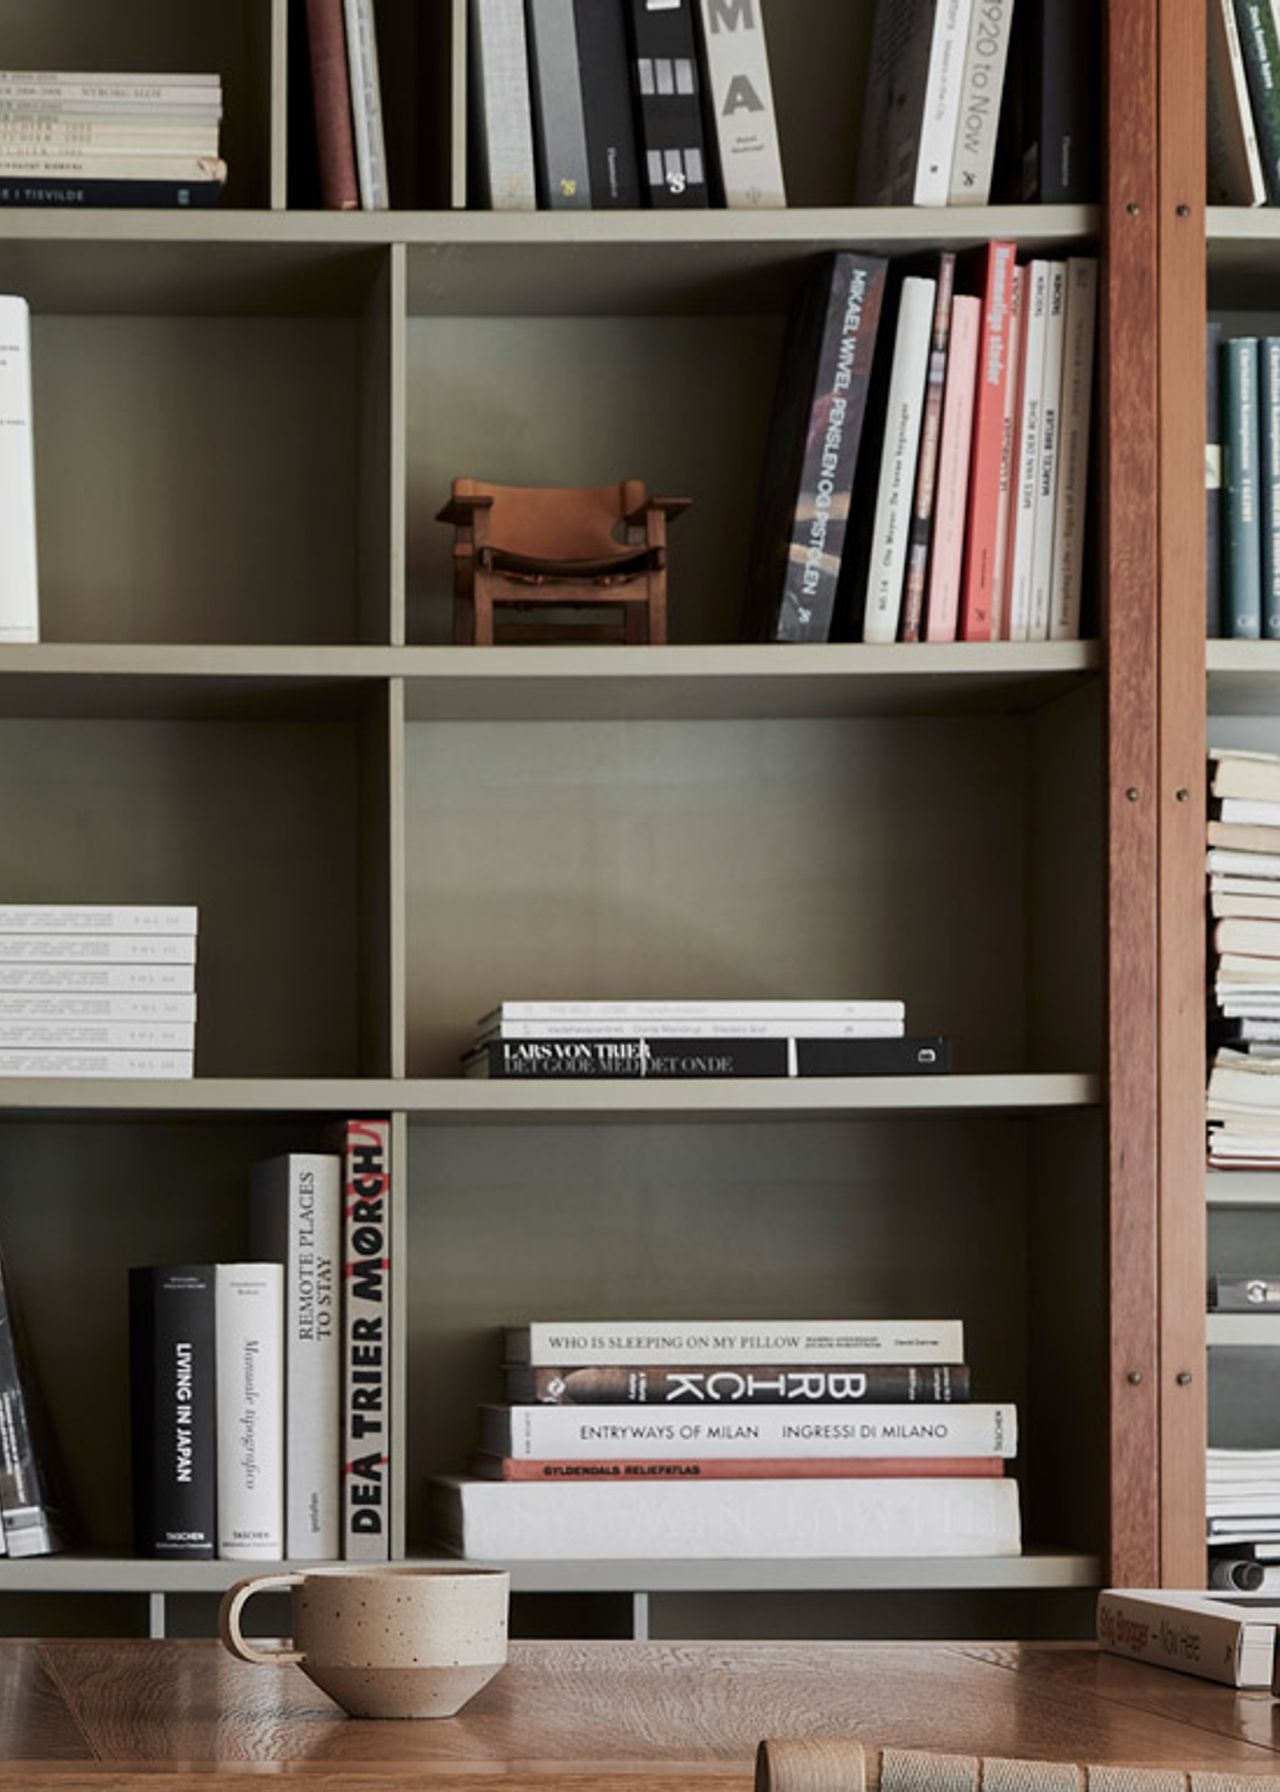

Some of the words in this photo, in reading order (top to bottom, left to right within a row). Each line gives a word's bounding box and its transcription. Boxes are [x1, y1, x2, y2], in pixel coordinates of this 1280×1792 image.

[971, 64, 993, 88] to
[965, 97, 991, 154] Now
[24, 189, 84, 201] TISVILDE
[842, 268, 868, 336] MIKAEL
[1052, 273, 1062, 316] TASCHEN
[836, 334, 858, 394] WIVEL
[820, 396, 848, 478] PENSLEN
[1045, 408, 1056, 450] BREUER
[817, 477, 834, 508] OG
[1042, 452, 1053, 496] MARCEL
[801, 508, 830, 596] PISTOLEN
[504, 1042, 552, 1059] LARS
[554, 1042, 592, 1059] VON
[594, 1042, 651, 1060] TRIER
[505, 1058, 538, 1073] DET
[543, 1058, 594, 1073] GODE
[599, 1058, 642, 1073] MED
[644, 1057, 677, 1073] DET
[681, 1056, 734, 1073] ONDE
[299, 1171, 315, 1247] PLACES
[352, 1146, 383, 1303] MØRCH
[299, 1249, 315, 1341] REMOTE
[317, 1257, 331, 1308] STAY
[317, 1310, 331, 1341] TO
[549, 1336, 588, 1349] WHO
[591, 1336, 607, 1349] IS
[609, 1336, 683, 1349] SLEEPING
[686, 1336, 709, 1349] ON
[713, 1336, 736, 1349] MY
[740, 1336, 800, 1349] PILLOW
[175, 1342, 193, 1401] LIVING
[242, 1340, 259, 1409] Manuale
[351, 1317, 383, 1440] TRIER
[666, 1372, 866, 1400] BRICK
[175, 1405, 192, 1424] IN
[580, 1424, 674, 1440] ENTRYWAYS
[679, 1424, 702, 1440] OF
[706, 1424, 759, 1440] MILAN
[782, 1424, 855, 1439] INGRESSI
[860, 1424, 877, 1439] DI
[880, 1424, 949, 1439] MILANO
[994, 1410, 1003, 1452] TASCHEN
[175, 1426, 192, 1483] JAPAN
[544, 1465, 621, 1476] GYLDENDALS
[625, 1465, 701, 1476] RELIEFATLAS
[351, 1452, 383, 1534] DEA
[166, 1531, 206, 1542] TASCHEN
[232, 1530, 270, 1541] TASCHEN
